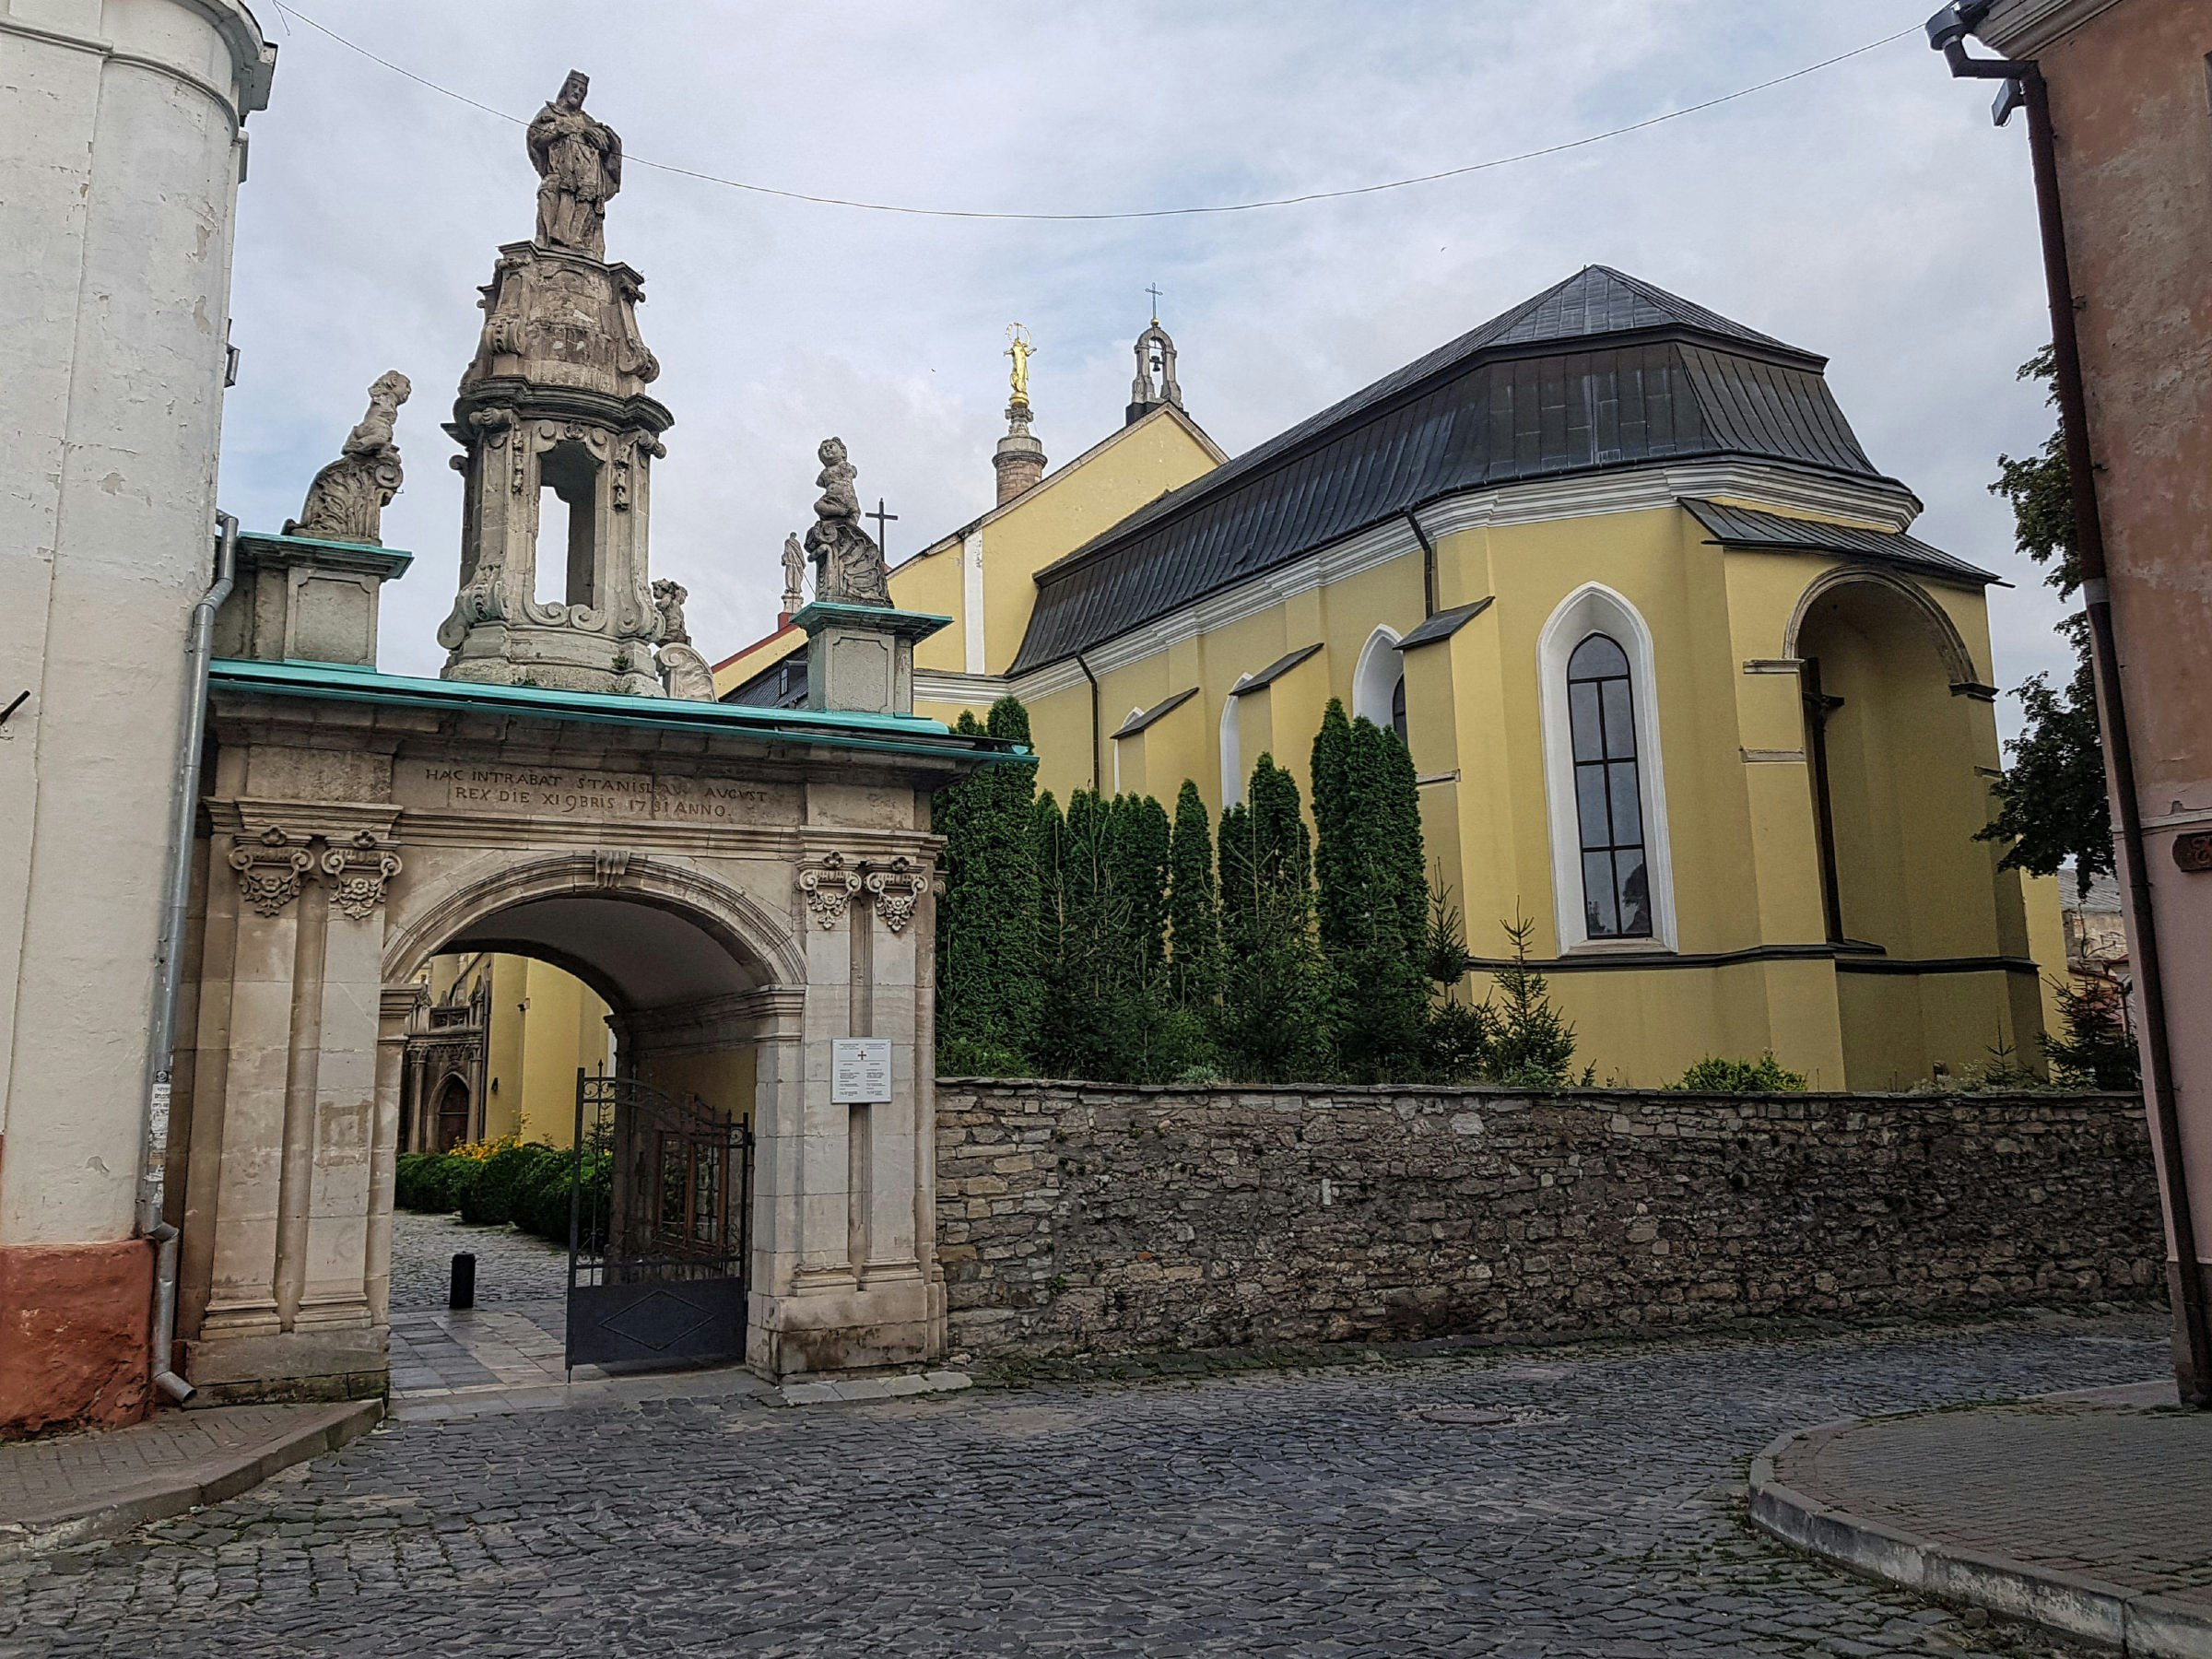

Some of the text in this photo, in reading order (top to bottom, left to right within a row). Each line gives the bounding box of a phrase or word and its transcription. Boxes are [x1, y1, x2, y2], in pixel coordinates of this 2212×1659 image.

[426, 769, 464, 781] HAC
[472, 768, 563, 786] INTRABAT
[455, 787, 491, 801] REX
[500, 788, 530, 804] DIE
